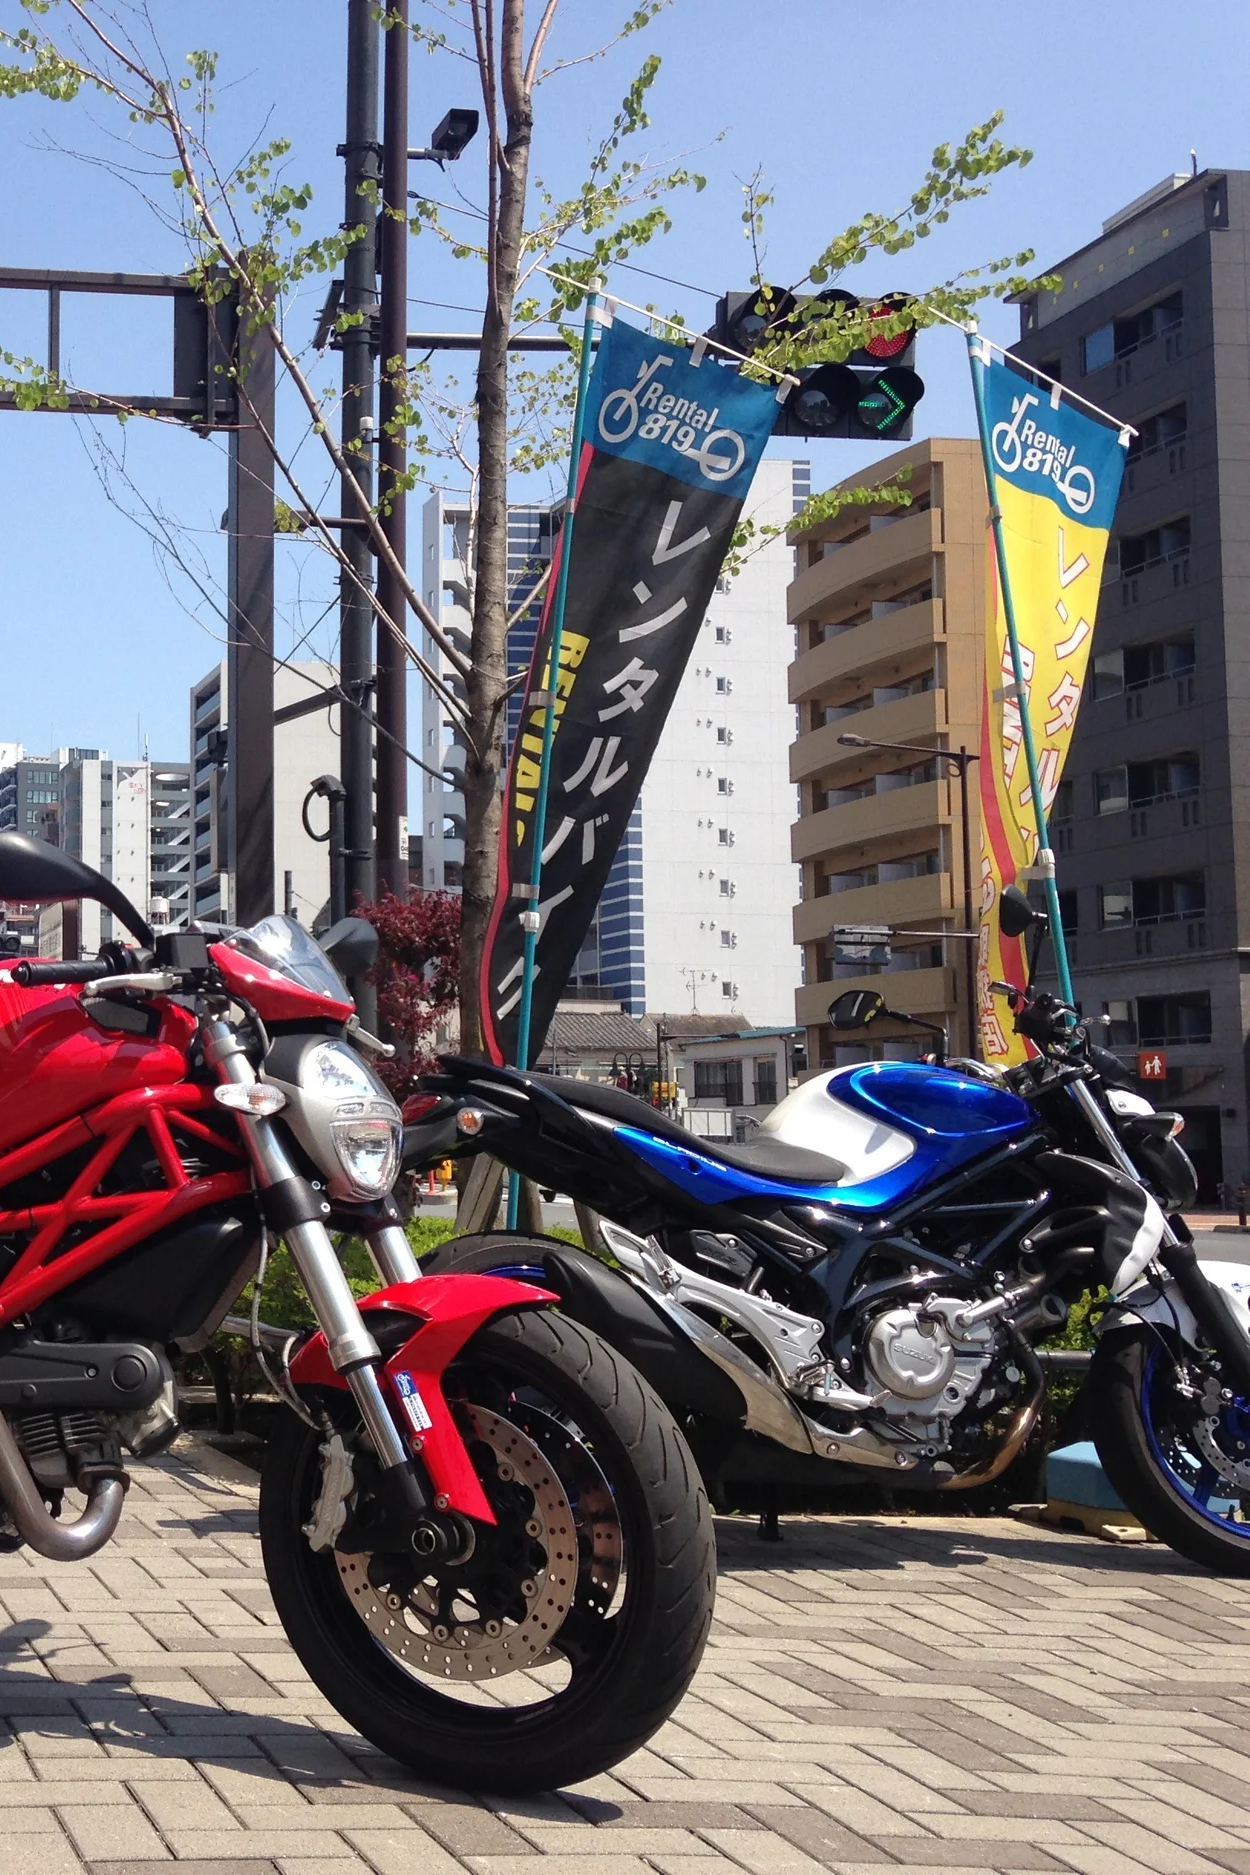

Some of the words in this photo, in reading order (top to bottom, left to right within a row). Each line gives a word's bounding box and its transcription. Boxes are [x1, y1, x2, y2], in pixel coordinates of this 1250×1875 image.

[640, 382, 719, 433] Rental
[638, 413, 696, 453] 819
[1020, 418, 1076, 468] Rental
[1022, 448, 1062, 483] 819
[1018, 526, 1091, 862] レンタル
[893, 1342, 937, 1366] SUZUKI
